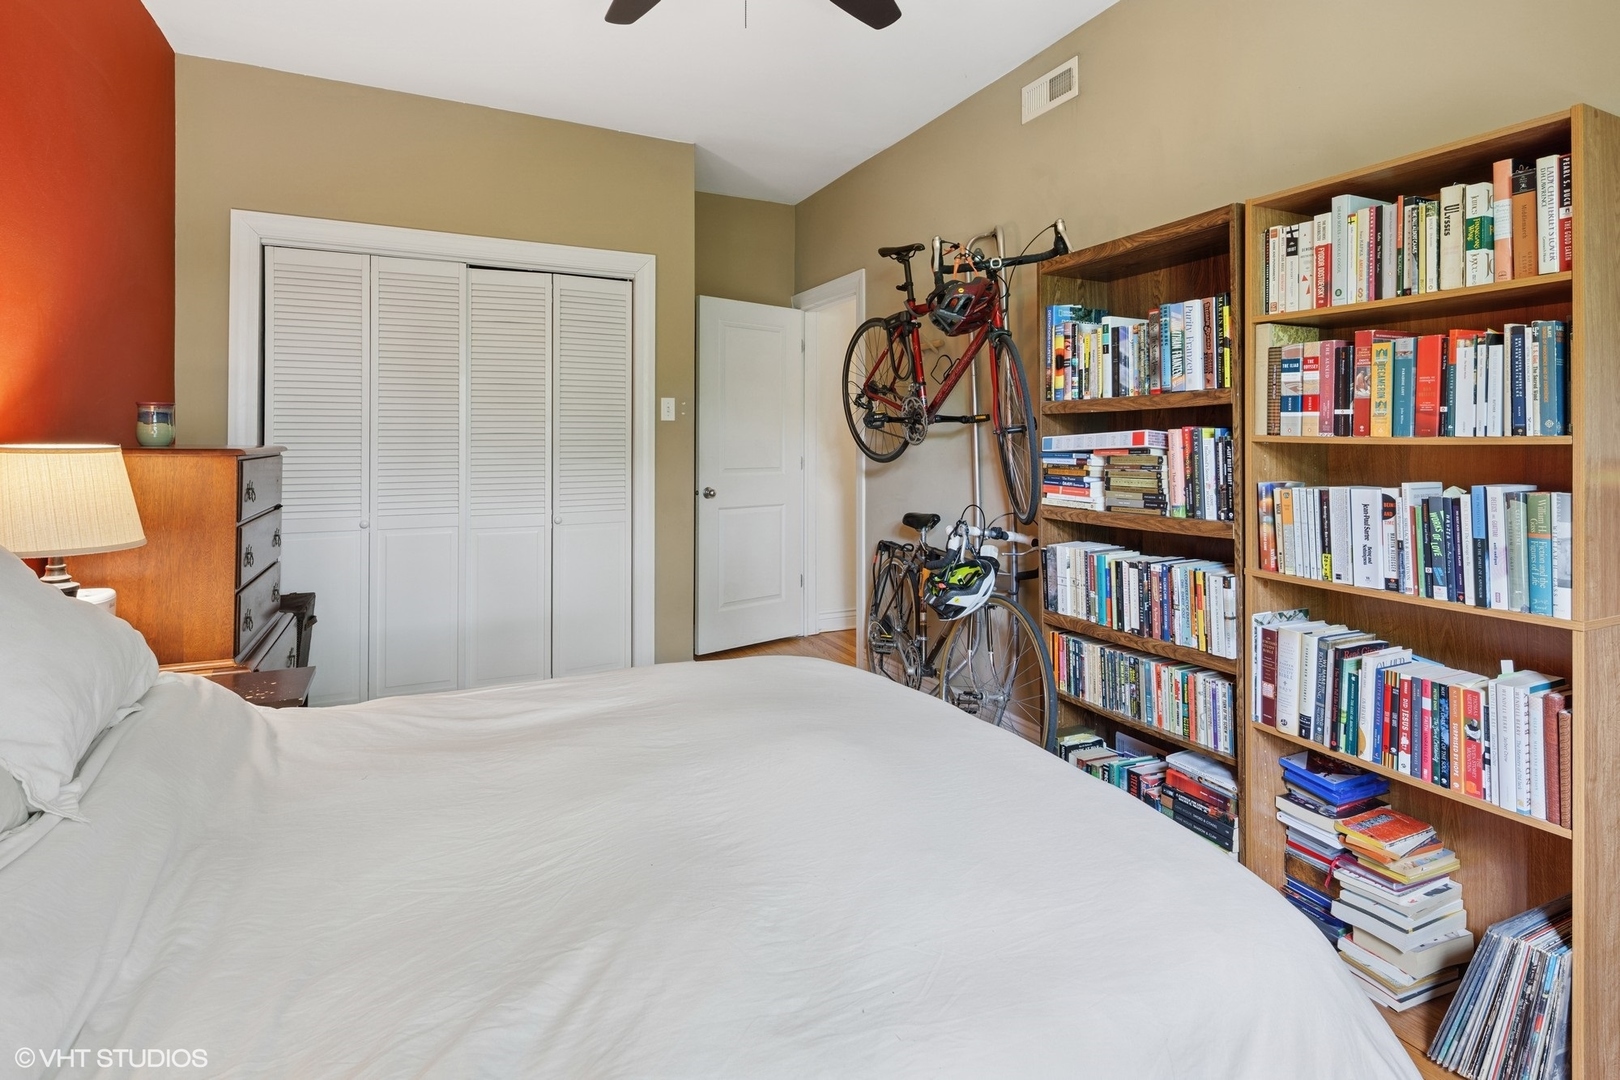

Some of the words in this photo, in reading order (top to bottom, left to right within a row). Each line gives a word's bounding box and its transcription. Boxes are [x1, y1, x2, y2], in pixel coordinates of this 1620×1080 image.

[1563, 179, 1570, 187] S.
[1471, 194, 1479, 215] James
[1563, 189, 1571, 206] BUCK
[1317, 247, 1325, 266] FYODOR
[1468, 253, 1478, 273] Joyce
[1317, 267, 1325, 298] DOSTOEVSKY
[1185, 305, 1194, 332] Purity
[1172, 350, 1184, 379] FRANZEN
[1186, 336, 1194, 375] Franzen
[1377, 365, 1386, 399] DECAMERON
[1361, 503, 1370, 526] Jean-Paul
[1537, 499, 1547, 524] William
[1429, 512, 1443, 533] WORKS
[1538, 525, 1546, 533] H.
[1432, 533, 1441, 542] OF
[1430, 542, 1443, 557] LOVE
[1530, 540, 1538, 566] Figures
[1539, 541, 1547, 563] Fiction
[1532, 572, 1540, 586] Life
[1539, 564, 1547, 577] and
[1323, 659, 1327, 668] WE
[1402, 709, 1410, 731] JESUS
[1453, 753, 1459, 761] BY
